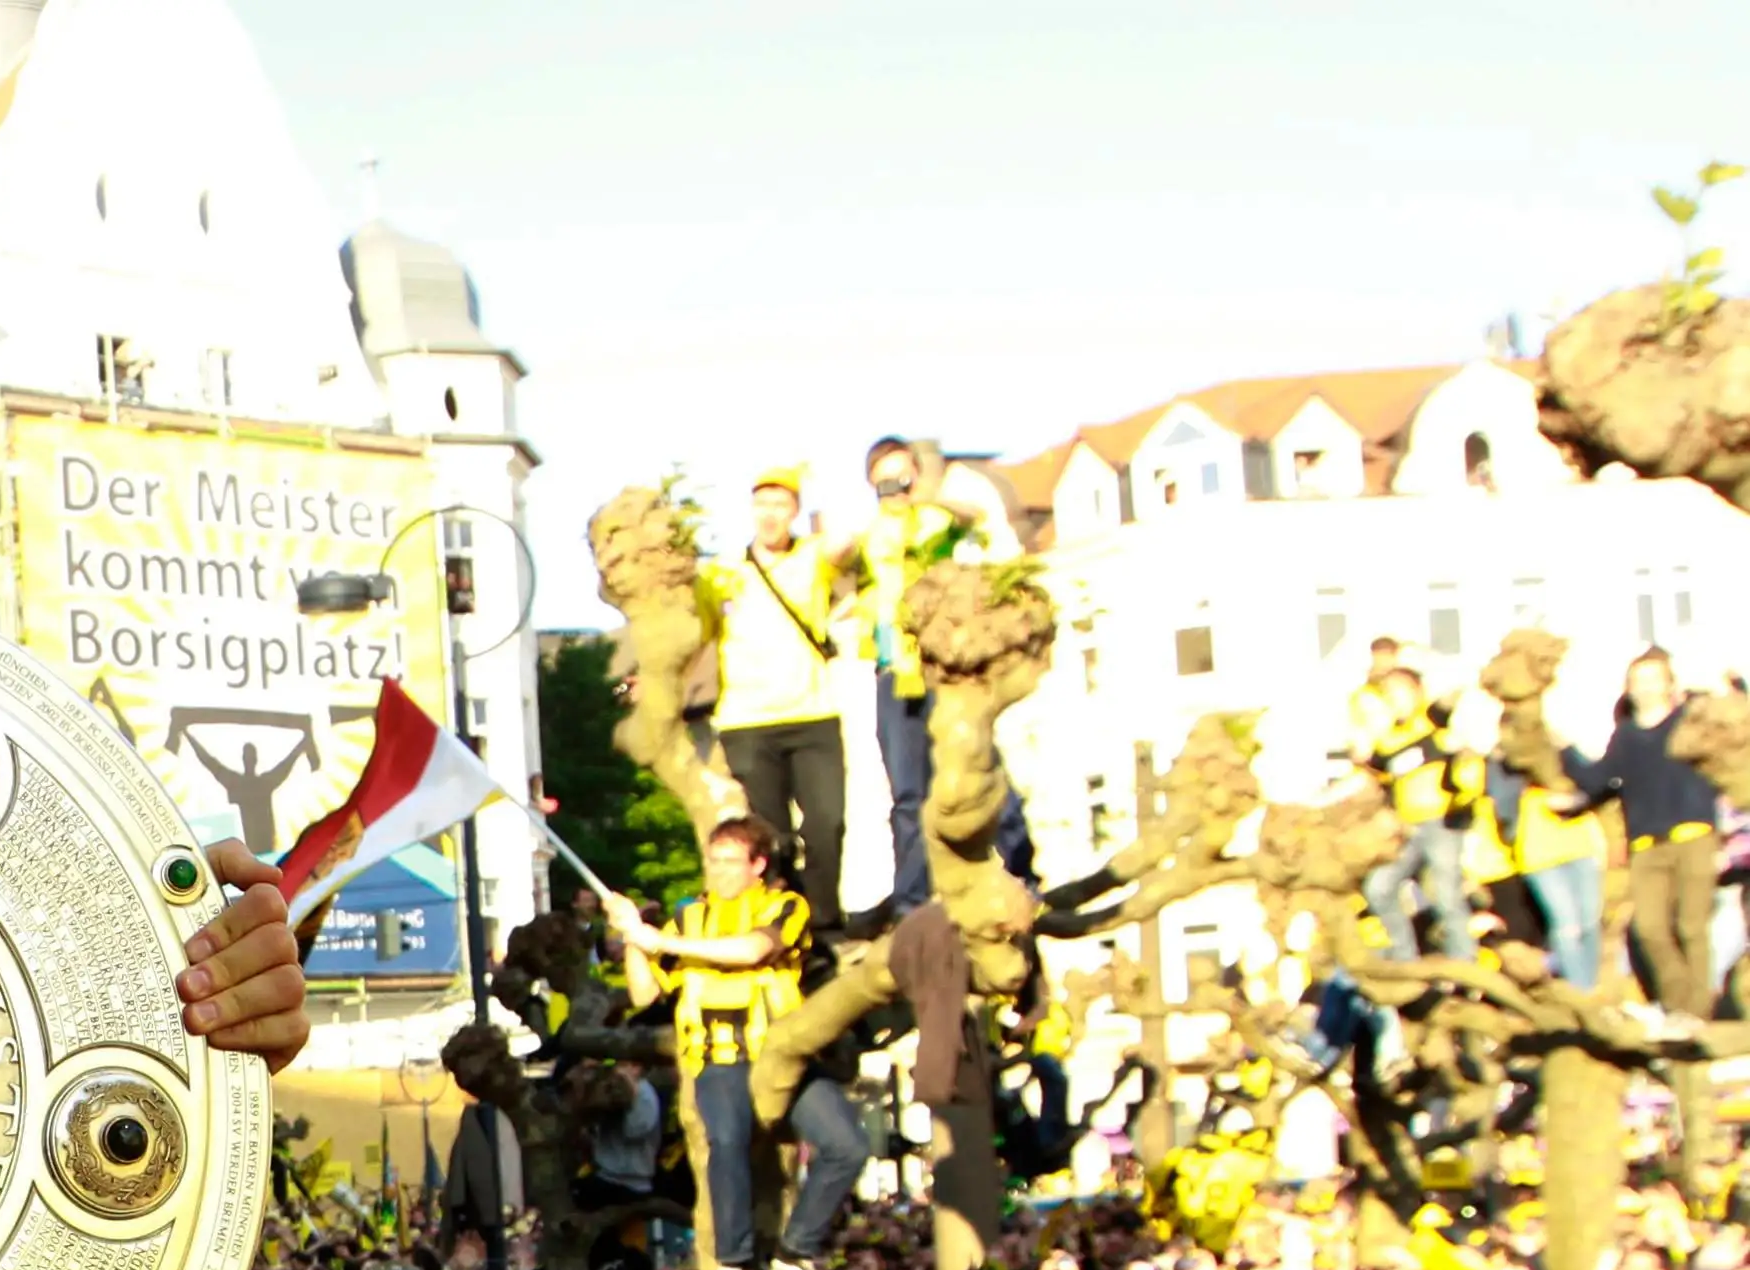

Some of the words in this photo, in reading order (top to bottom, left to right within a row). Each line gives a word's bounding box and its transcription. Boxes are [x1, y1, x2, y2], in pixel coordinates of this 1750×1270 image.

[62, 456, 161, 517] Der
[198, 471, 398, 539] Meister
[66, 530, 268, 600] kommt
[70, 609, 404, 689] Borsigplatz!
[230, 1084, 242, 1114] 2004
[230, 1117, 241, 1136] SV
[248, 1089, 259, 1117] 1989
[248, 1120, 259, 1137] FC
[223, 1138, 241, 1196] WERDER
[243, 1139, 258, 1191] BAYERN
[210, 1199, 233, 1255] BREMEN
[228, 1193, 254, 1262] MÜNCHEN
